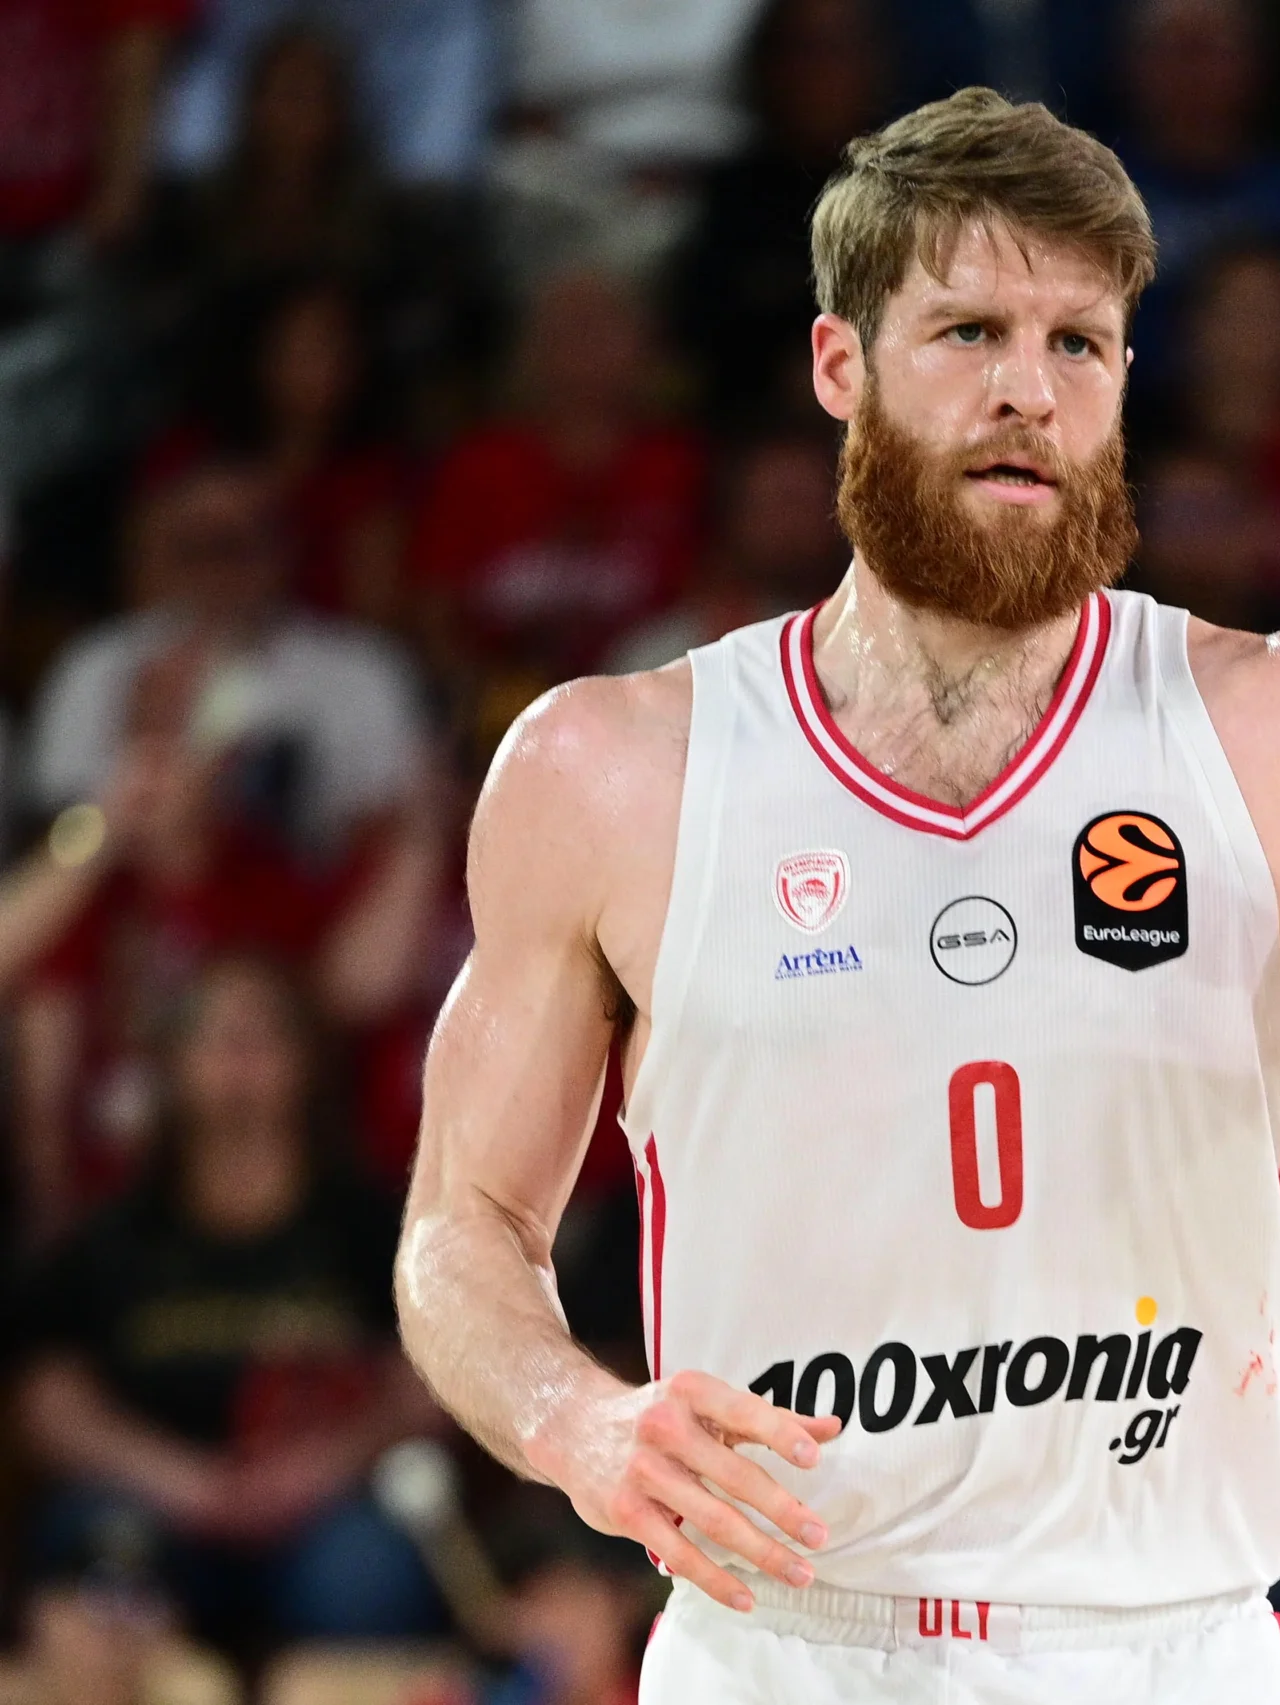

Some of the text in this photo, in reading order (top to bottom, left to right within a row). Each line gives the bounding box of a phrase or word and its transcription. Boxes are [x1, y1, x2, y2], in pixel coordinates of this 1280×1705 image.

[937, 928, 1011, 950] GSA
[1083, 925, 1181, 947] EuroLeague
[946, 1060, 1024, 1230] 0
[748, 1296, 1203, 1433] 100xronia
[1109, 1404, 1180, 1464] .gr
